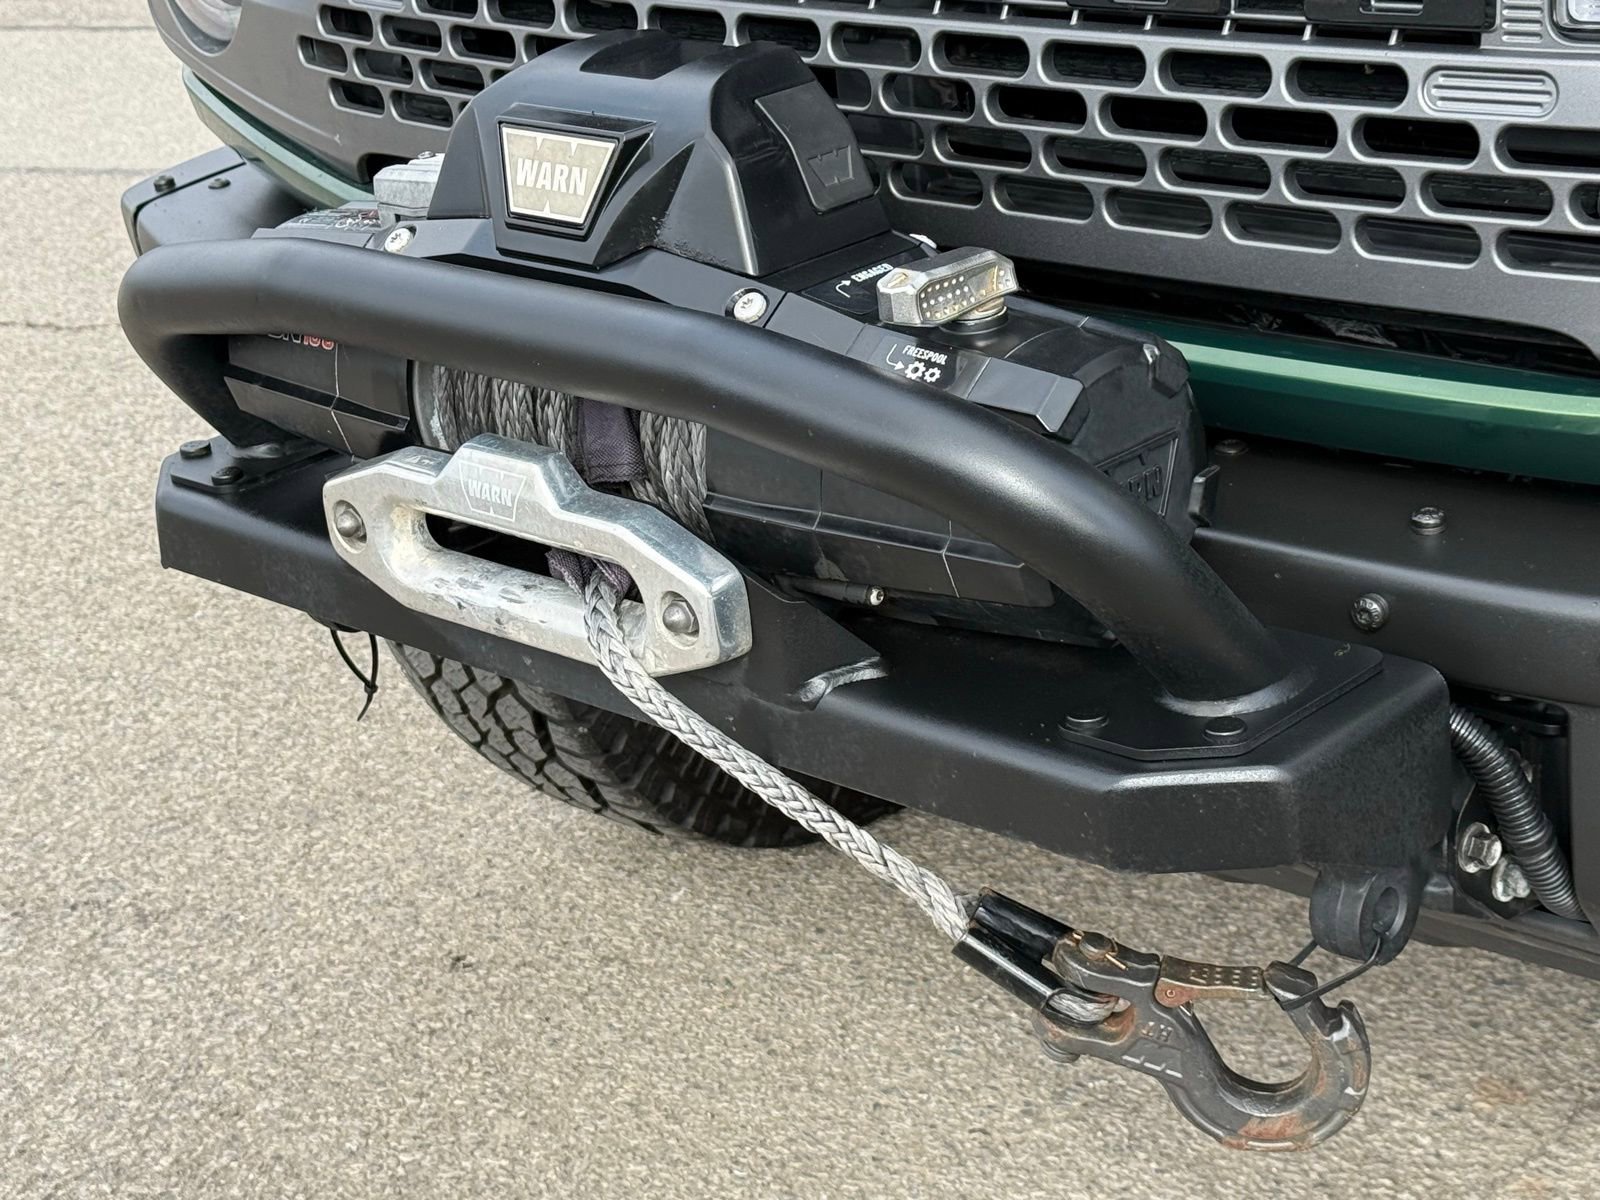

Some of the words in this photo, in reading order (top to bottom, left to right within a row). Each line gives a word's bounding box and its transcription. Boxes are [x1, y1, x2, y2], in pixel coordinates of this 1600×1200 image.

[516, 157, 588, 196] WARN
[850, 263, 894, 283] ENGAGED
[902, 344, 948, 365] FREESPOOL
[467, 478, 513, 508] WARN
